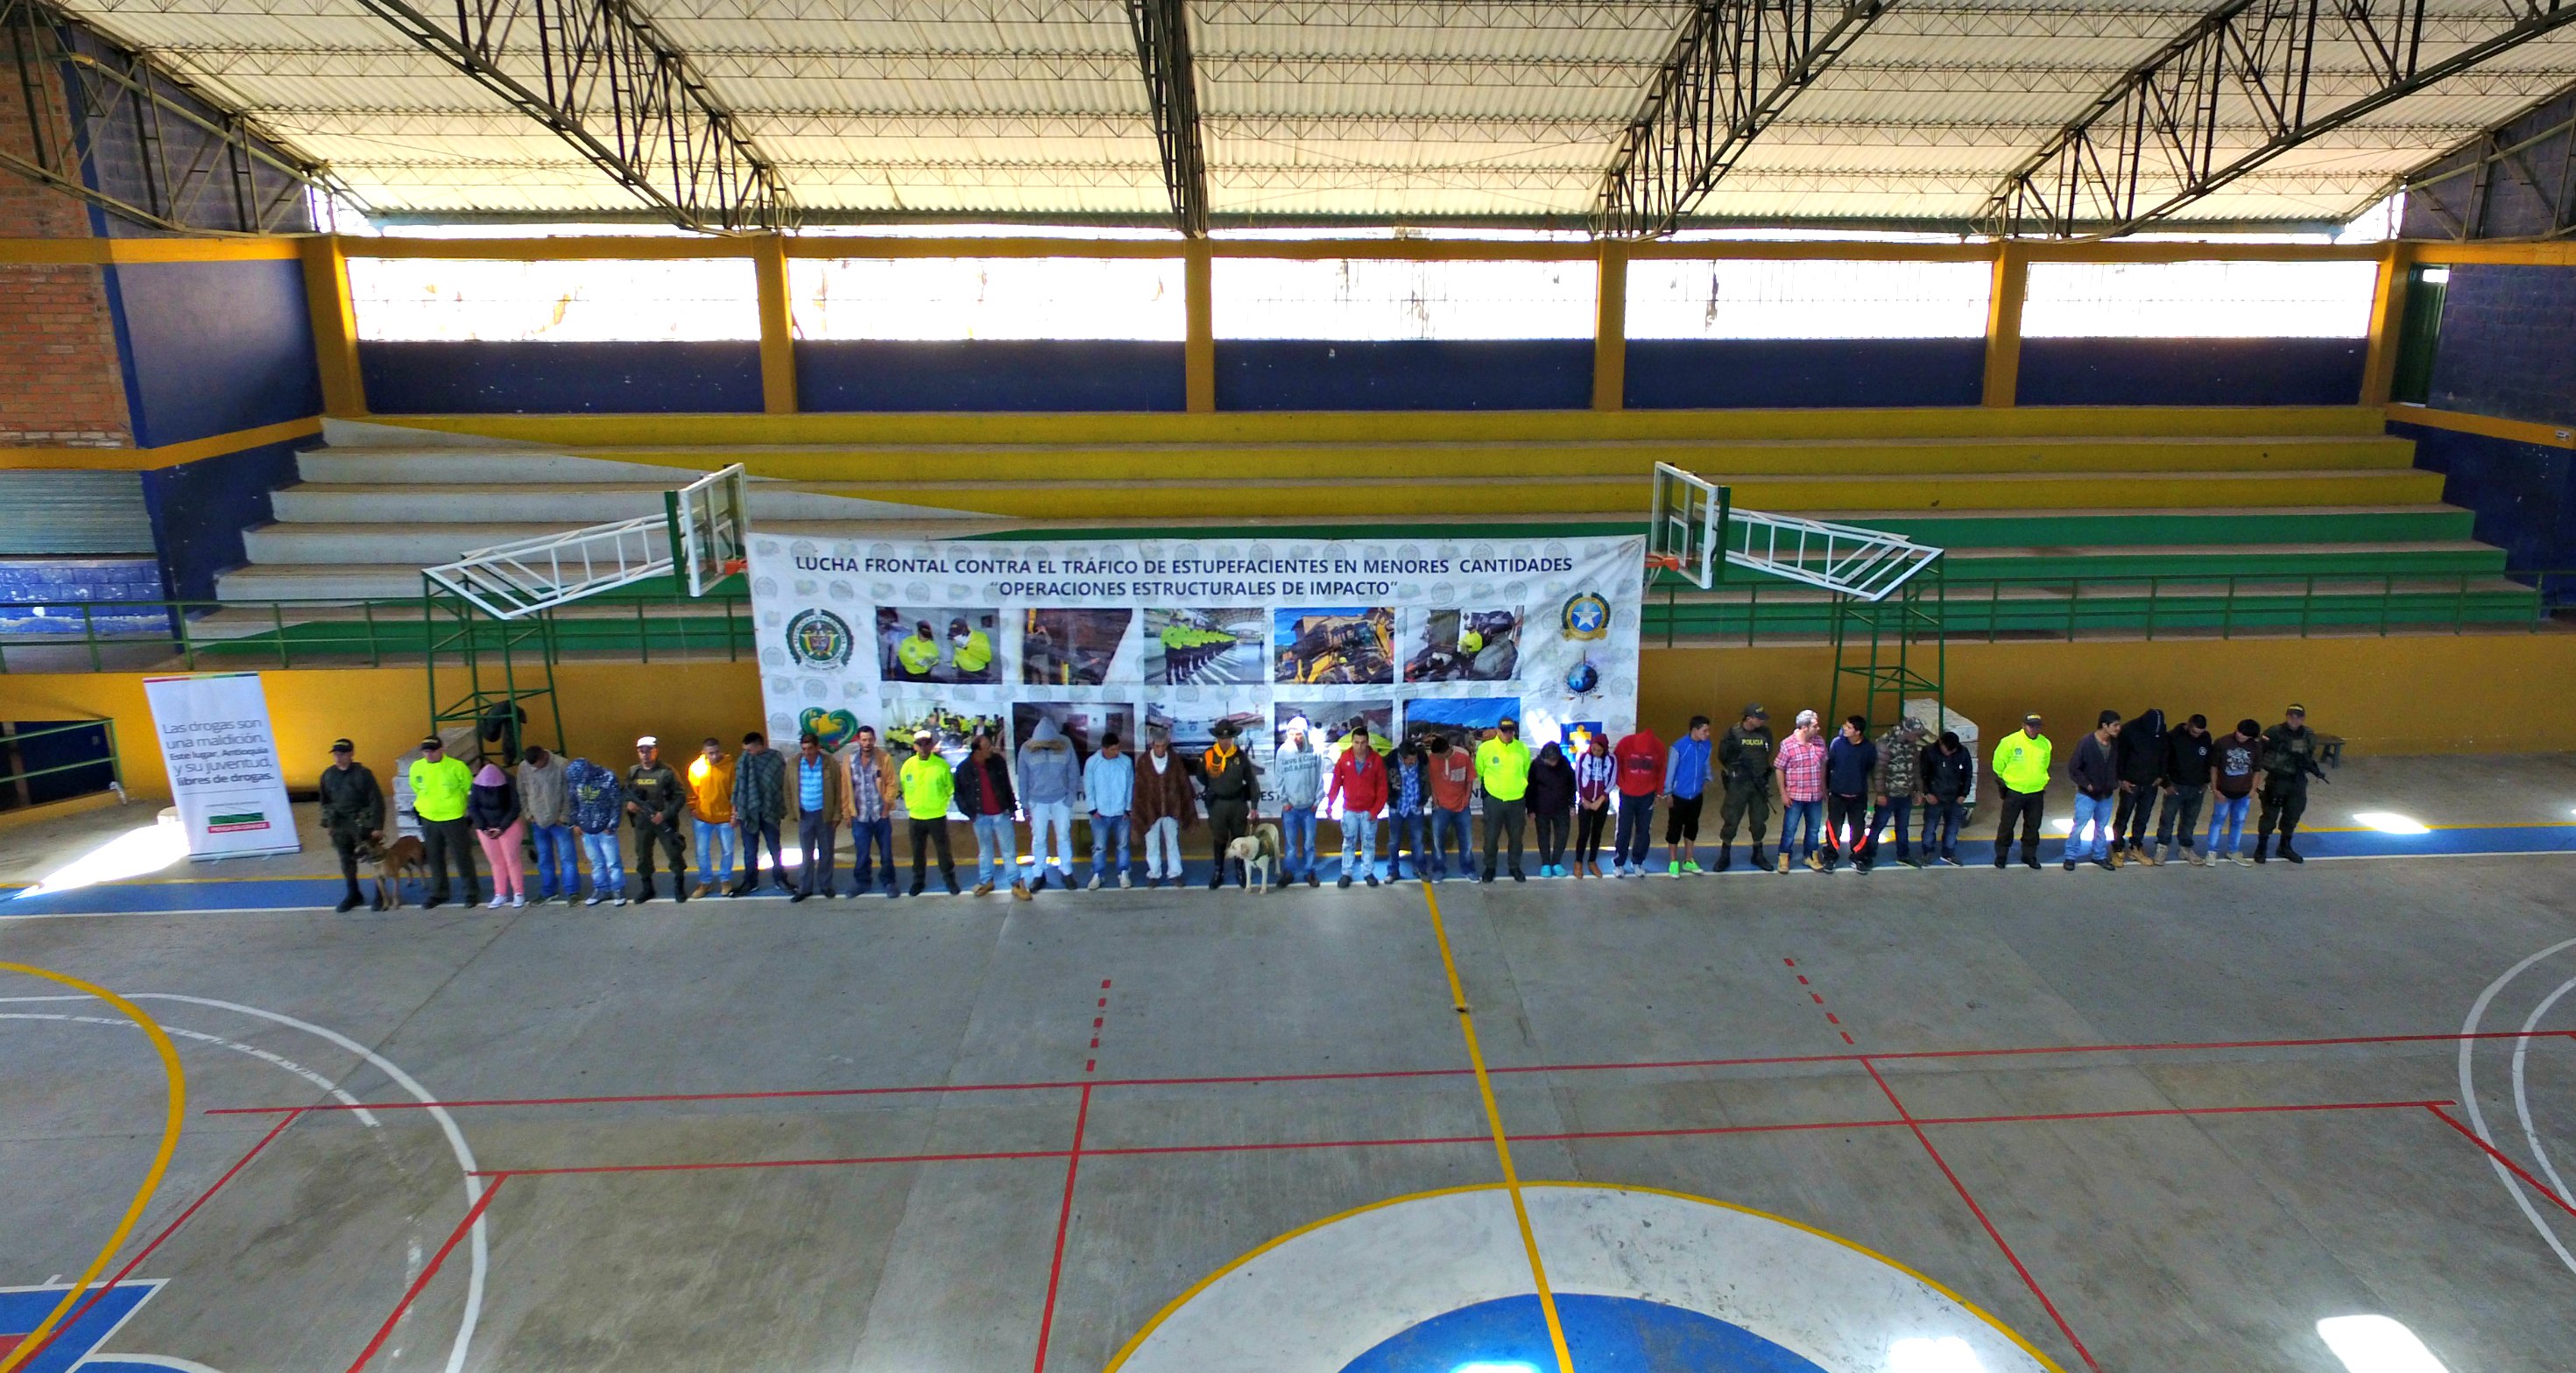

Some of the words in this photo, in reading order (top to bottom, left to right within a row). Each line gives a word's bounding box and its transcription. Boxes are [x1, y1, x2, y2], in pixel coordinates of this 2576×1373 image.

[795, 557, 859, 573] LUCHA
[865, 558, 949, 574] FRONTAL
[955, 559, 1032, 574] CONTRA
[1037, 560, 1057, 574] EL
[1062, 556, 1138, 574] TRÁFICO
[1144, 560, 1167, 574] DE
[1172, 559, 1329, 574] ESTUPEFACIENTES
[1334, 559, 1358, 574] EN
[1364, 559, 1450, 574] MENORES
[1459, 557, 1573, 574] CANTIDADES
[1132, 581, 1276, 596] ESTRUCTURALES
[1282, 581, 1304, 596] DE
[163, 724, 187, 734] Las
[188, 721, 236, 734] drogas
[236, 719, 262, 729] son
[166, 738, 194, 750] una
[196, 733, 267, 747] maldición.
[170, 752, 192, 761] Este
[222, 747, 269, 757] Antioquia
[174, 765, 182, 778] y
[186, 764, 203, 773] su
[177, 777, 211, 787] libres
[213, 774, 229, 784] de
[229, 772, 274, 784] drogas.
